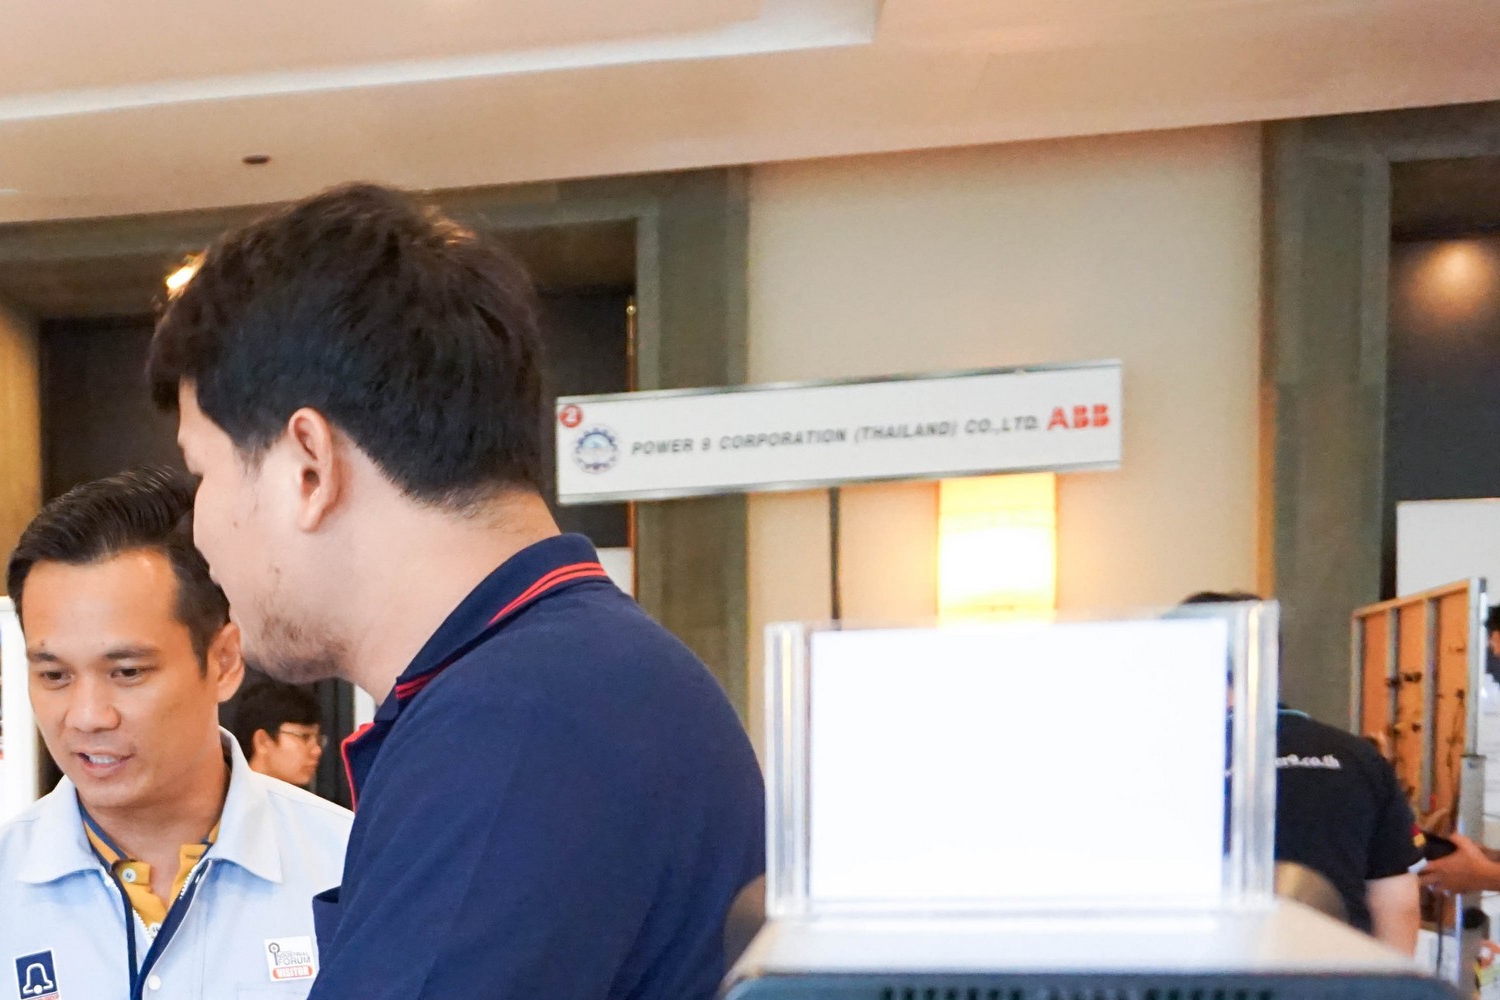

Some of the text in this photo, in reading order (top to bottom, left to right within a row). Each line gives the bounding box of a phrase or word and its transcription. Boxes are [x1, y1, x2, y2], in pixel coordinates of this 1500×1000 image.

[1046, 403, 1111, 431] ABB
[631, 437, 694, 455] POWER
[719, 428, 848, 450] CORPORATION
[854, 420, 957, 444] (THAILAND)
[277, 956, 311, 966] FORUM
